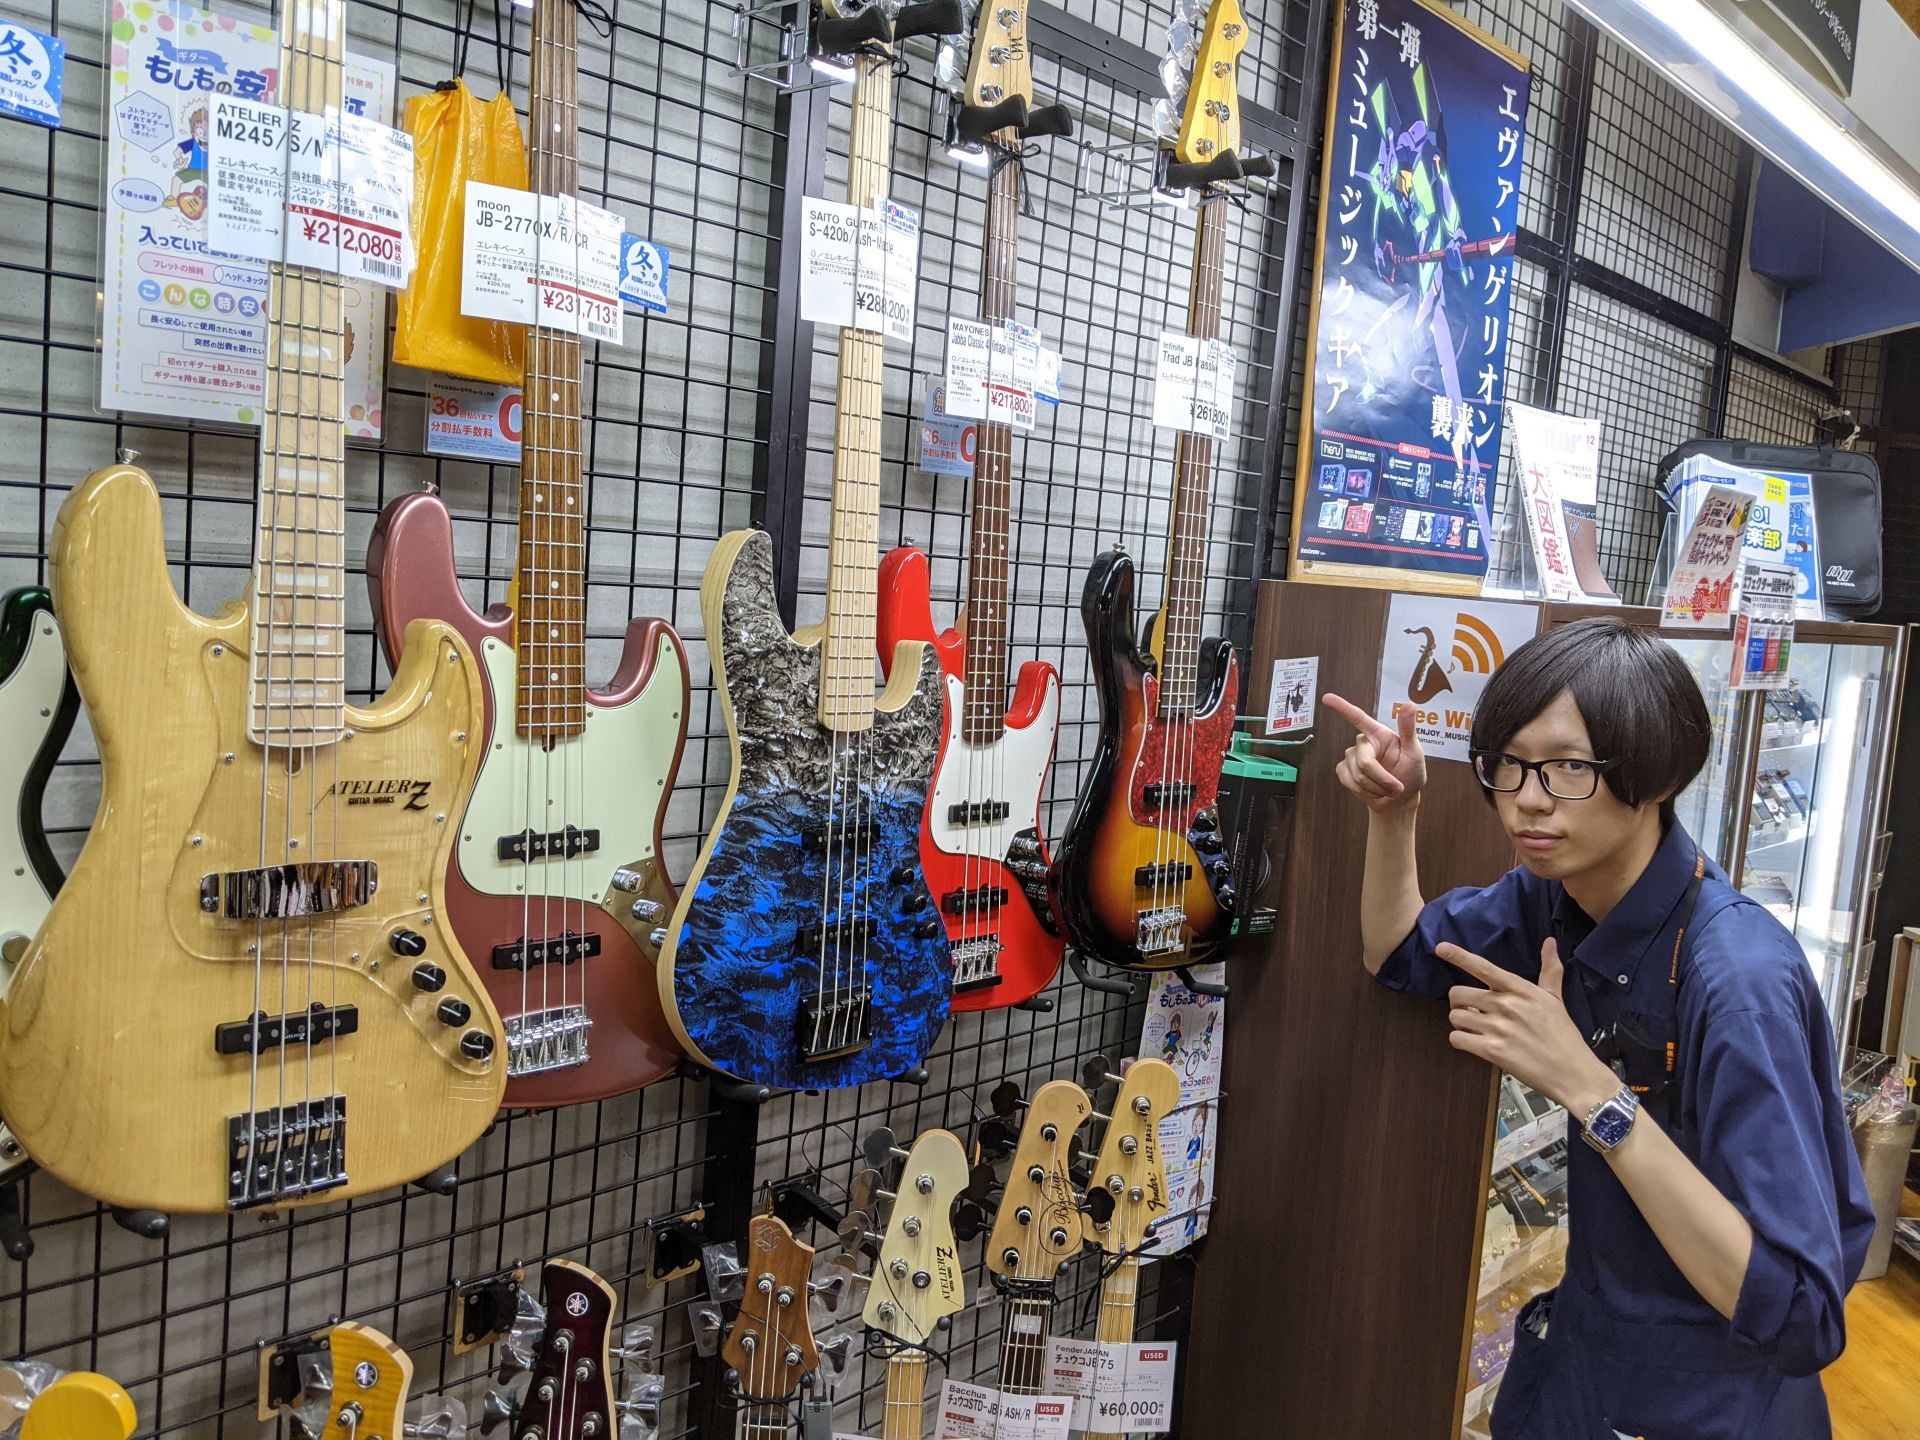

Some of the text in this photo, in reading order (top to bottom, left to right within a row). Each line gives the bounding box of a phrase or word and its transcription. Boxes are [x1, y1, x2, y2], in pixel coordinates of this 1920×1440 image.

[217, 103, 301, 132] ATELIER Z
[288, 204, 314, 215] SALE
[477, 199, 511, 213] moon
[809, 210, 840, 225] SAITO
[1326, 47, 1369, 414] ミュージックギア
[303, 217, 393, 261] ¥212,080
[476, 241, 526, 256] エレキベース
[1475, 84, 1520, 448] エヴァンゲリオン
[543, 289, 611, 325] ¥231,713
[952, 322, 990, 337] MAYONES
[1163, 341, 1185, 353] Infinite
[1162, 350, 1181, 365] Trad
[1183, 355, 1193, 367] JB
[1431, 395, 1475, 444] 襲来
[1586, 434, 1596, 446] 12
[1767, 488, 1782, 496] FREE
[1743, 526, 1782, 552] 楽部
[1391, 703, 1439, 726] Fee
[1417, 737, 1445, 746] himamura
[373, 796, 395, 805] WORKS
[403, 780, 431, 811] Z
[1144, 1122, 1155, 1164] JAZZ BASS
[1147, 1172, 1167, 1212] Fender
[1055, 1345, 1110, 1358] FenderJAPAN
[948, 1384, 987, 1400] Bacchus
[1004, 1405, 1031, 1421] ASH/R
[1099, 1401, 1158, 1417] ¥60,000
